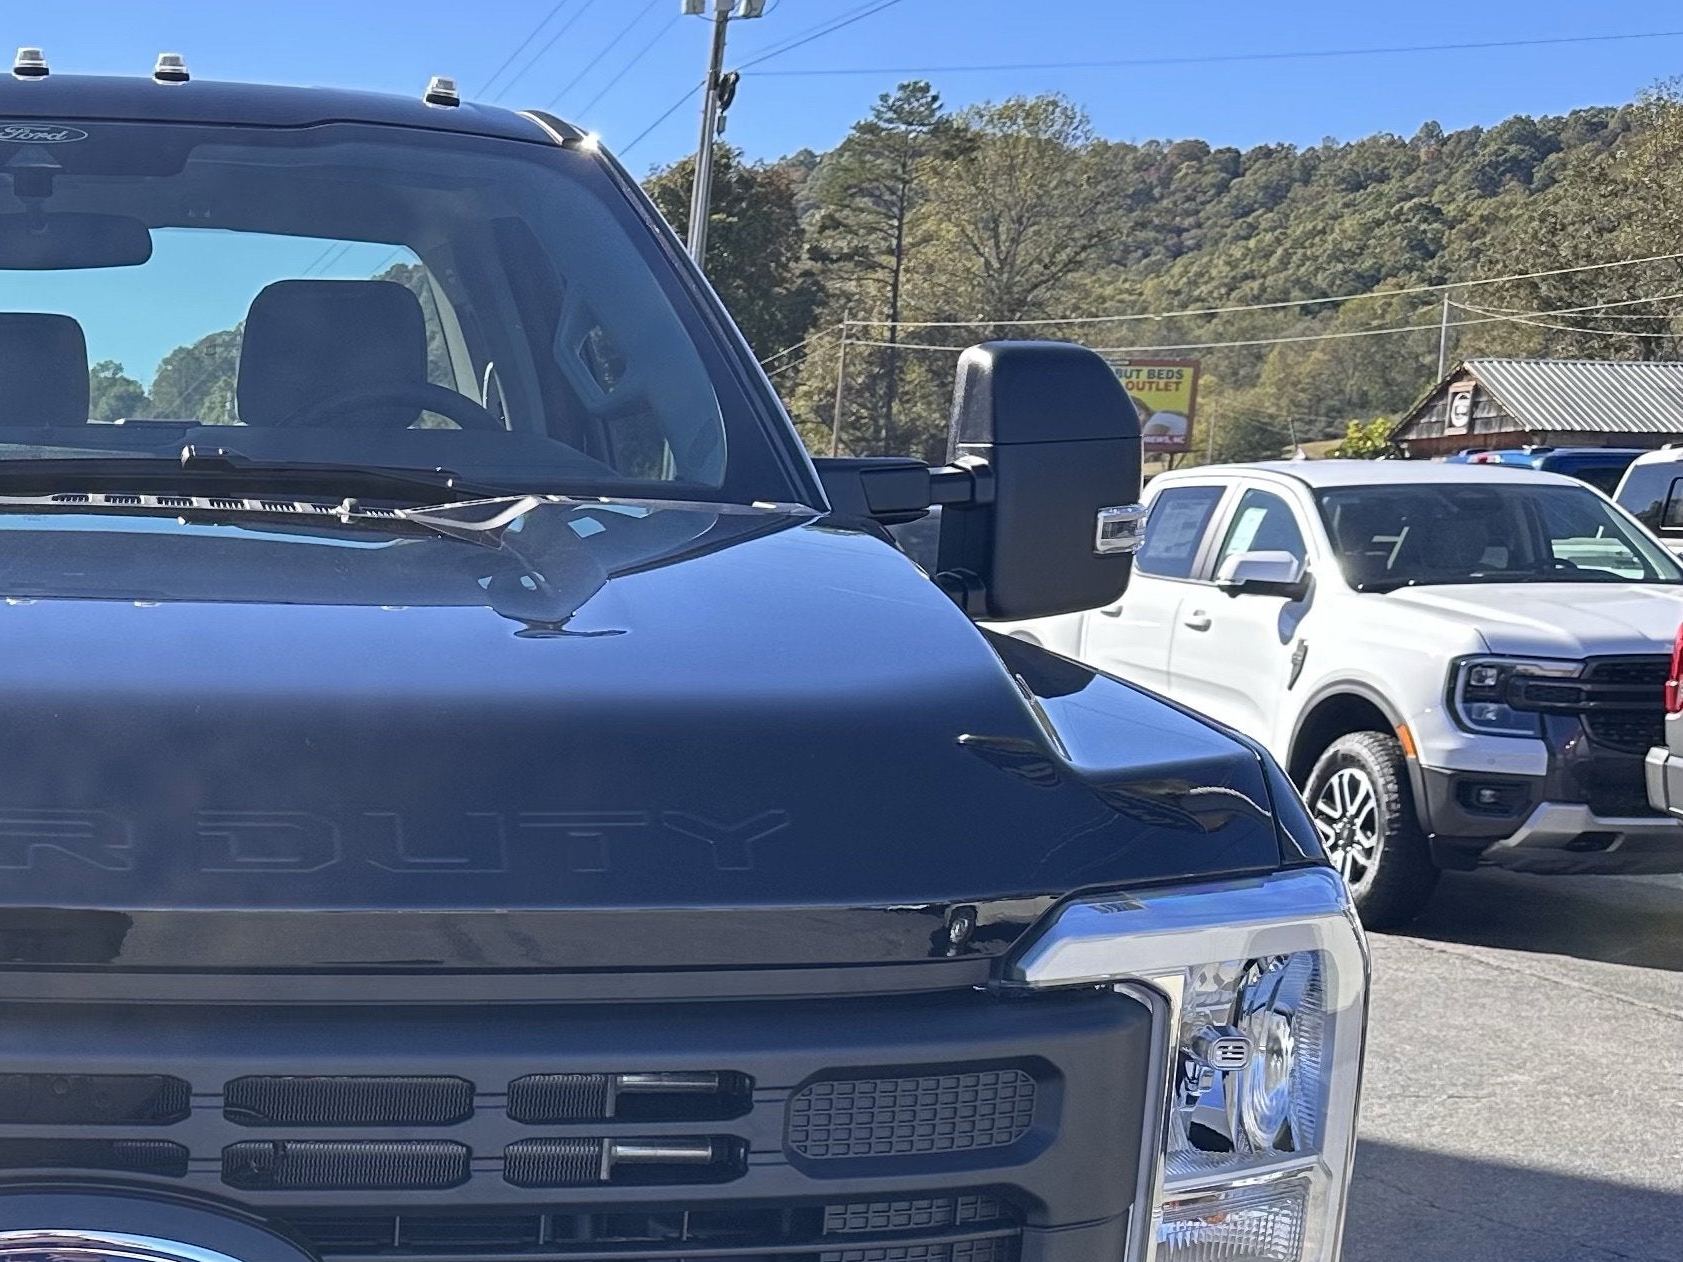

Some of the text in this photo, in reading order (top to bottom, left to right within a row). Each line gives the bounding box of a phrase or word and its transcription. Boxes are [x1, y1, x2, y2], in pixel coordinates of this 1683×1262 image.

[1147, 369, 1184, 380] BEDS
[1125, 380, 1182, 392] OUTLET
[196, 808, 790, 873] DUTY
